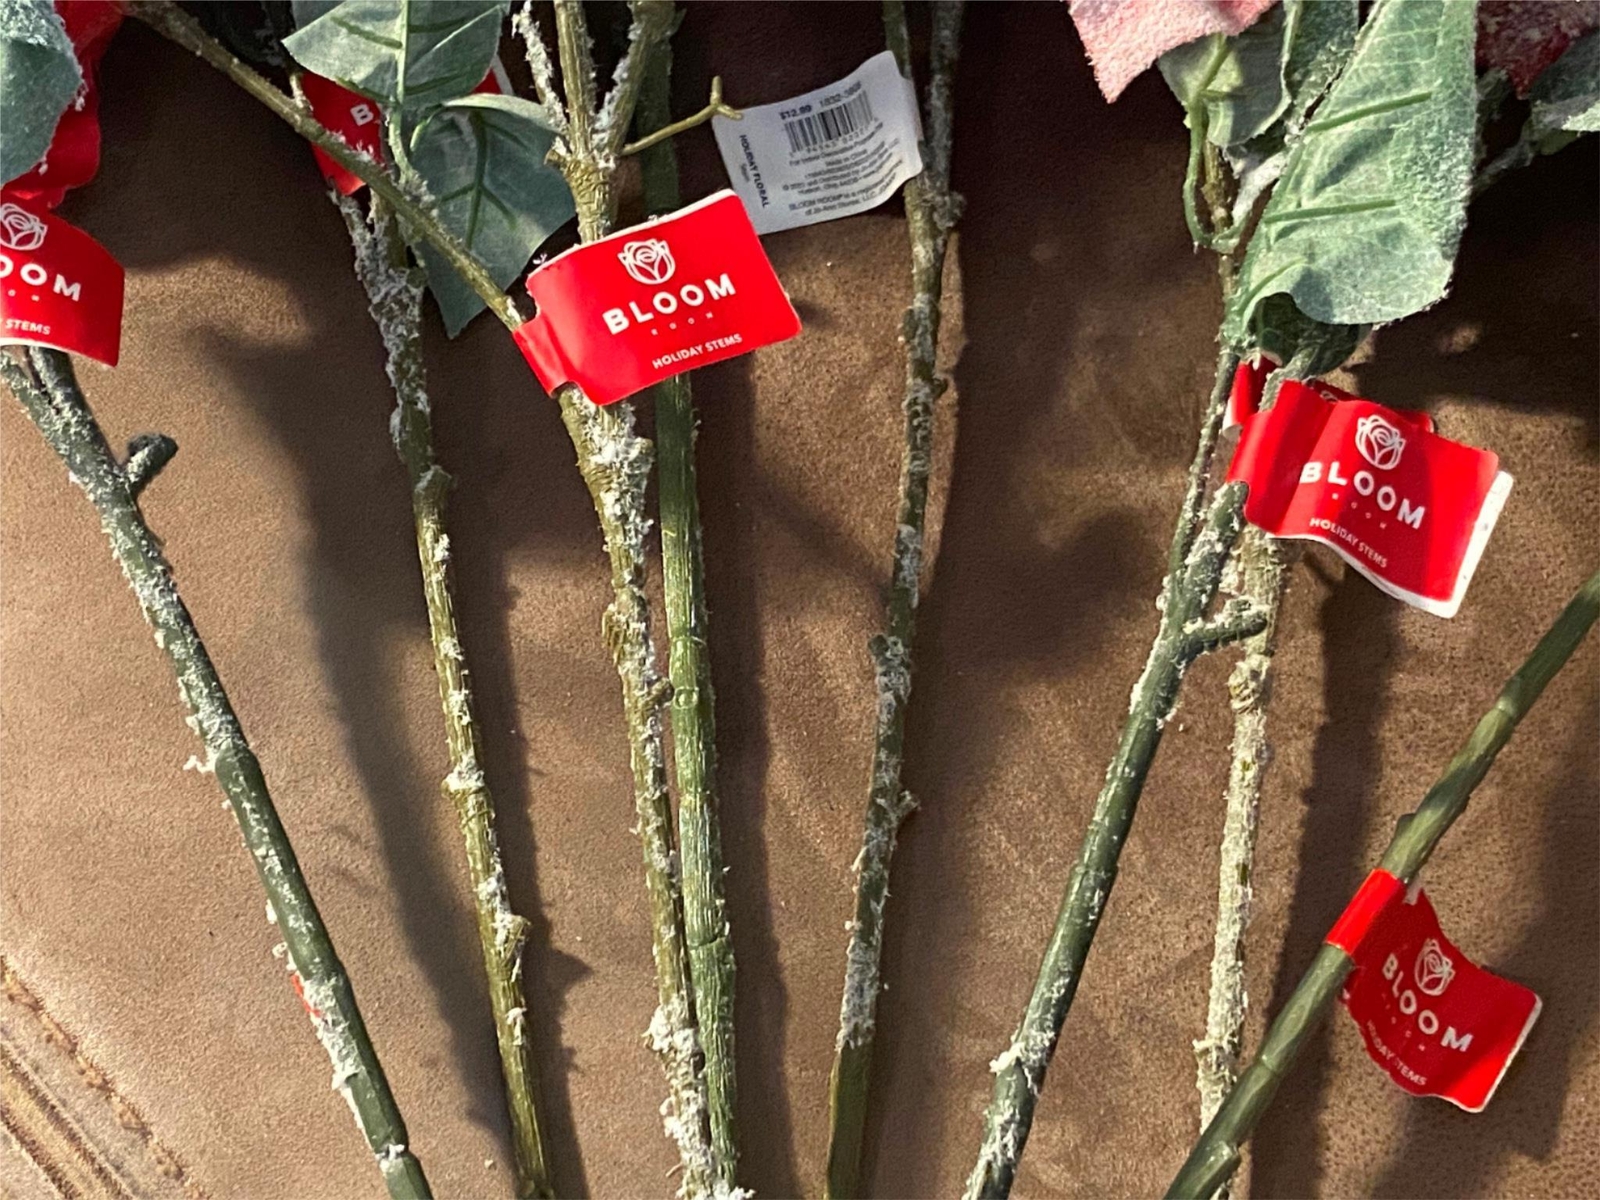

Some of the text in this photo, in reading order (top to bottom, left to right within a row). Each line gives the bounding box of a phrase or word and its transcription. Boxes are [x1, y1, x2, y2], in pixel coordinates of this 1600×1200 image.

[753, 172, 770, 209] FLORAL
[5, 319, 51, 335] STEMS
[602, 273, 736, 335] BLOOM
[652, 333, 742, 369] HOLIDAY STEMS
[1300, 461, 1425, 530] BLOOM
[1309, 517, 1388, 568] HOLIDAY STEMS
[1382, 953, 1473, 1052] BLOOM
